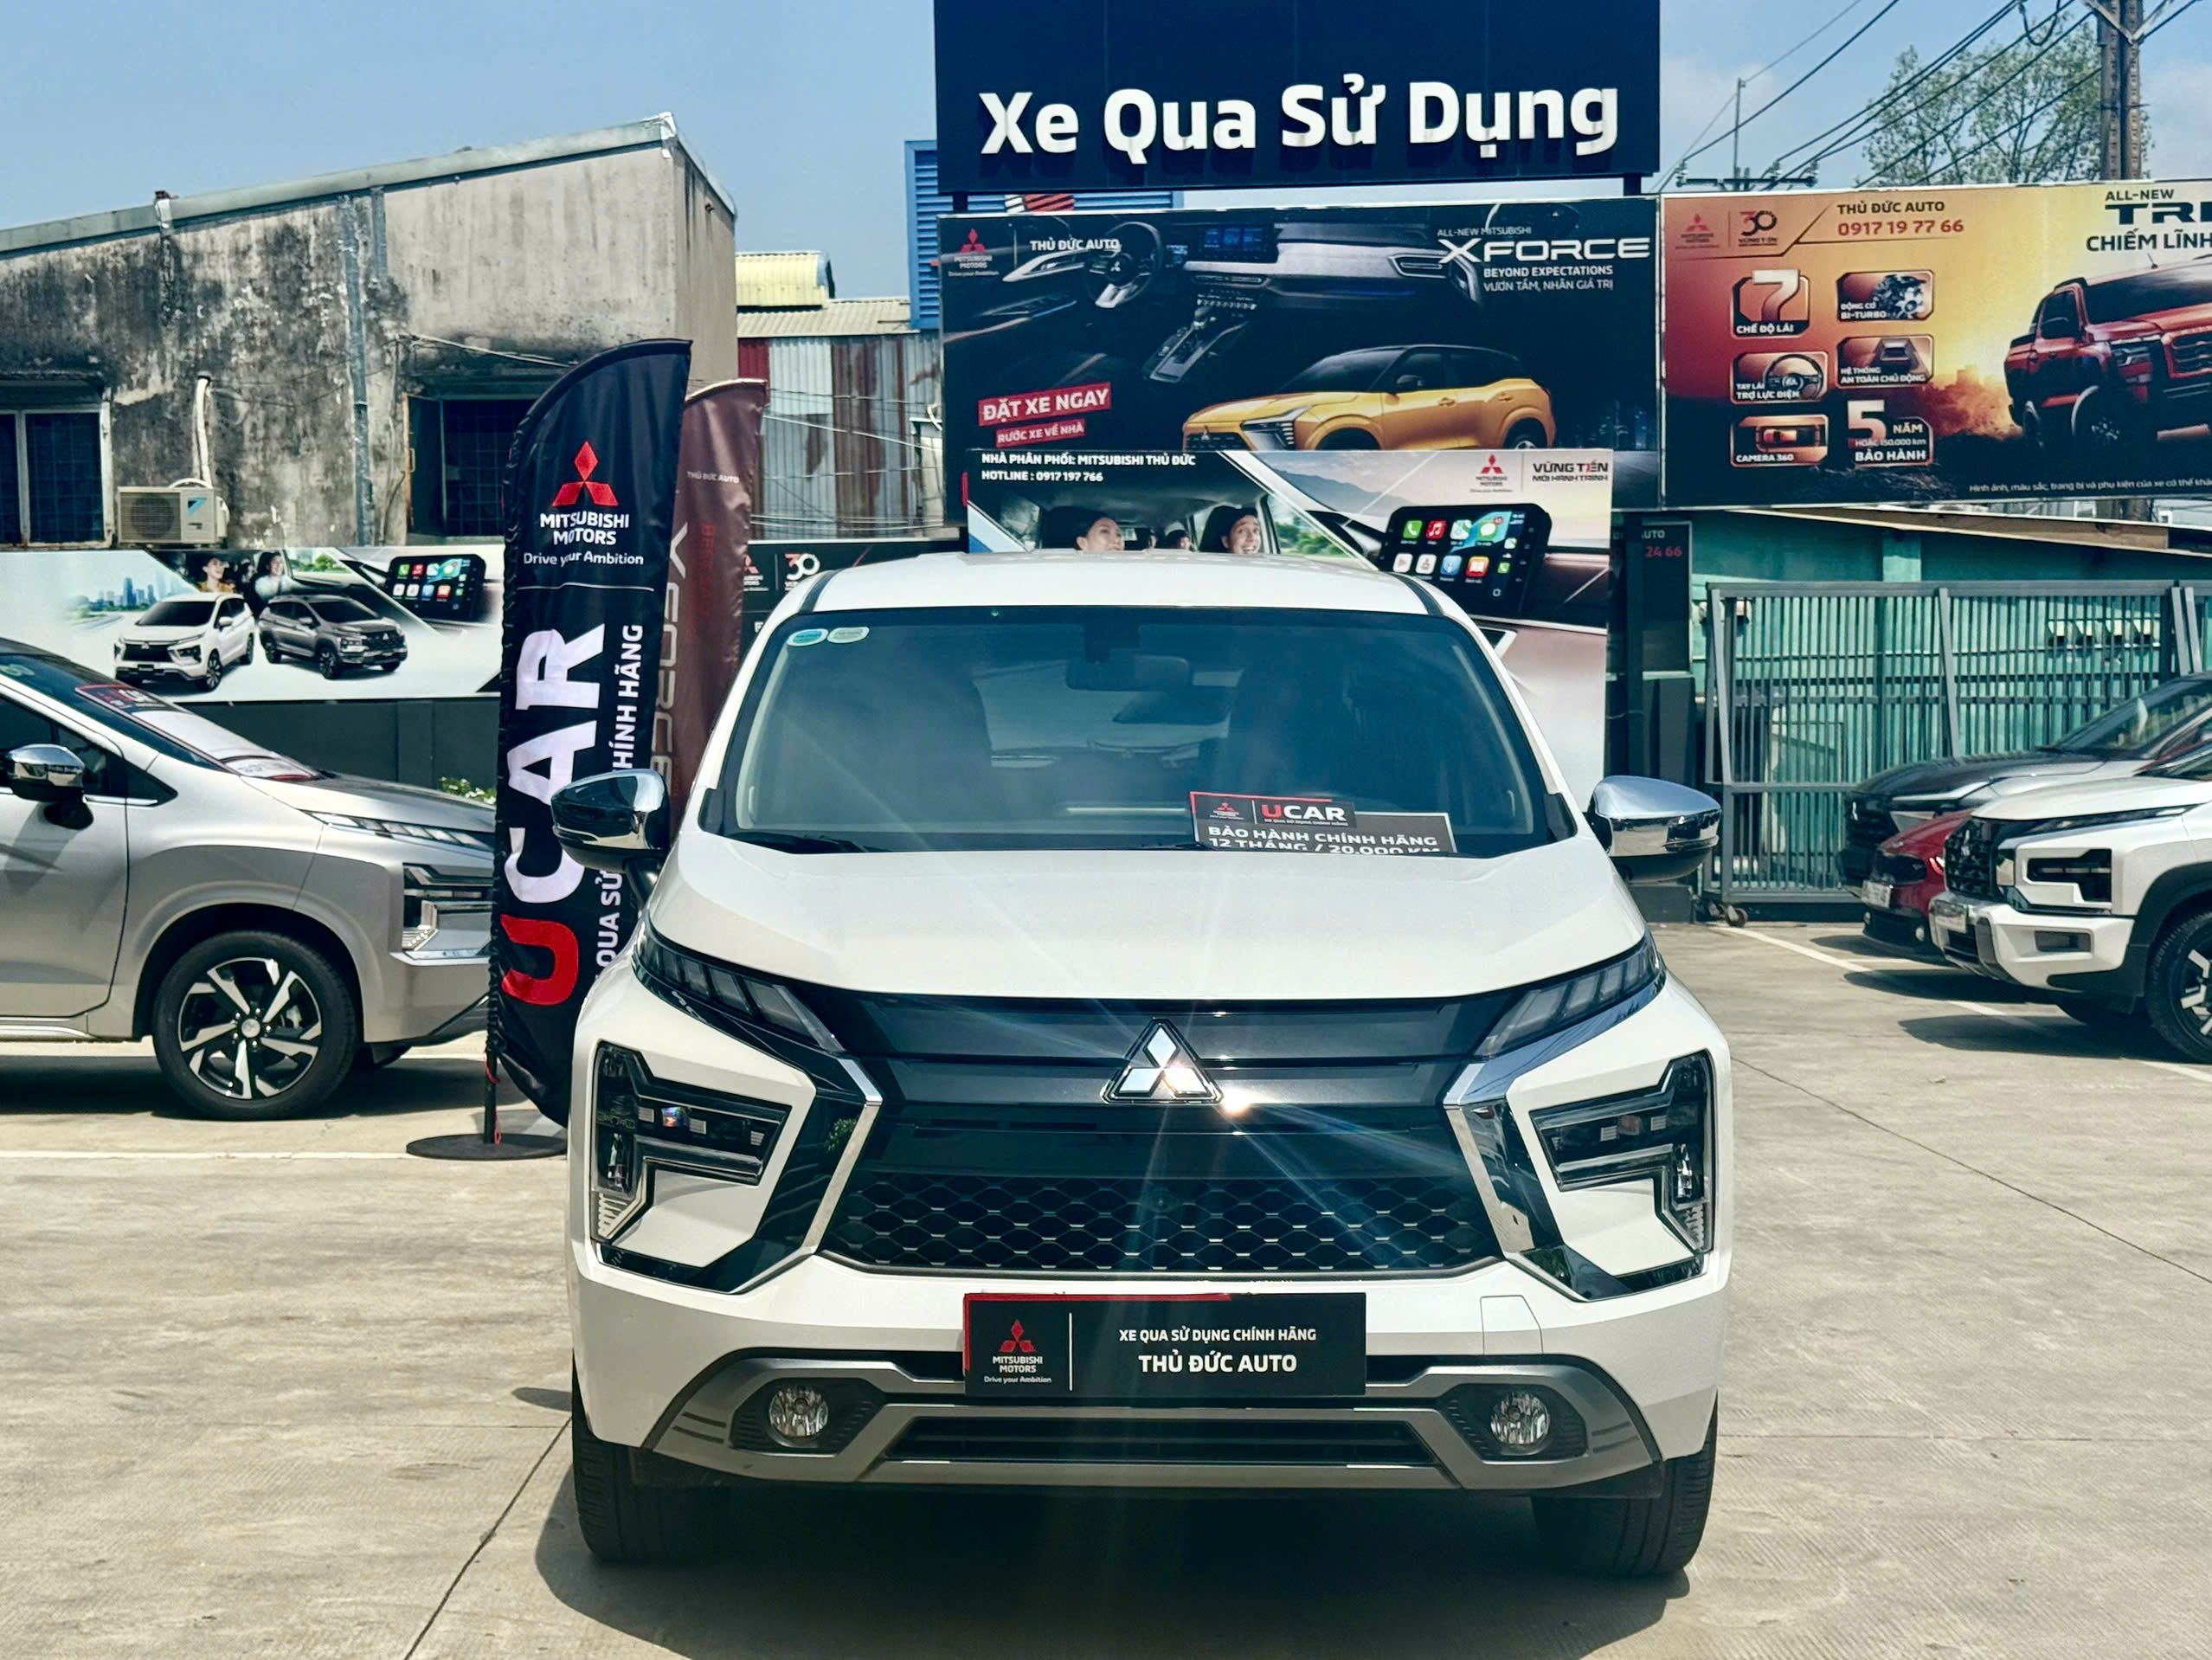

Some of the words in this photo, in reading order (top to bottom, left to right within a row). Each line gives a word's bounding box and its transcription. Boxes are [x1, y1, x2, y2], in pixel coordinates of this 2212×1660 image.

[980, 92, 1079, 154] Xe
[1103, 88, 1257, 165] Qua
[1281, 74, 1386, 148] Sử
[1409, 81, 1618, 159] Dụng
[2105, 190, 2174, 202] ALL-NEW
[1837, 201, 1868, 215] THỦ
[1871, 200, 1901, 214] ĐỨC
[1905, 202, 1945, 213] AUTO
[1437, 228, 1480, 237] ALL-NEW
[1481, 226, 1532, 235] MITSUBISHI
[1837, 222, 1882, 236] 0917
[1888, 221, 1908, 235] 19
[1913, 220, 1935, 234] 77
[1940, 219, 1964, 233] 66
[1030, 236, 1057, 251] THỦ
[1058, 236, 1083, 251] ĐỨC
[1086, 239, 1121, 250] AUTO
[2087, 228, 2157, 251] CHIẾM
[1438, 237, 1650, 264] XFORCE
[1483, 267, 1529, 278] BEYOND
[1532, 265, 1613, 277] EXPECTATIONS
[1576, 278, 1595, 290] GIÁ
[1596, 279, 1613, 291] TRỊ
[1752, 269, 1801, 323] 7
[1736, 322, 1759, 334] CHẾ
[1759, 322, 1775, 335] ĐỘ
[1776, 323, 1794, 334] LÁI
[983, 397, 1021, 422] ĐẶT
[1026, 396, 1051, 415] XE
[1055, 388, 1109, 411] NGAY
[1029, 428, 1043, 440] XE
[1060, 421, 1084, 434] NHÀ
[1847, 399, 1887, 447] 5
[1893, 422, 1923, 434] NĂM
[981, 453, 1008, 464] NHÀ
[1009, 453, 1042, 465] PHÂN
[1077, 454, 1143, 466] MITSUBISHI
[1146, 452, 1169, 466] THỦ
[1172, 452, 1196, 466] ĐỨC
[1855, 448, 1884, 461] BẢO
[1887, 448, 1926, 460] HÀNH
[1577, 459, 1609, 473] TIẾN
[981, 470, 1028, 481] HOTLINE
[1036, 471, 1062, 482] 0917
[1063, 471, 1082, 481] 197
[1083, 472, 1103, 482] 766
[540, 511, 629, 529] MITSUBISHI
[553, 528, 617, 545] MOTORS
[524, 552, 557, 565] Drive
[560, 552, 582, 568] your
[583, 550, 644, 565] Ambition
[614, 623, 643, 698] HÃNG
[608, 705, 638, 770] HÍNH
[1261, 803, 1347, 821] UCAR
[1208, 825, 1249, 838] BẢO
[1253, 827, 1309, 842] HÀNH
[1315, 832, 1376, 845] CHÍNH
[1381, 833, 1437, 846] HÃNG
[1209, 838, 1232, 847] 12
[1119, 1329, 1137, 1342] XE
[1140, 1329, 1169, 1343] QUA
[1172, 1325, 1191, 1342] SỬ
[1192, 1329, 1231, 1344] DỤNG
[1233, 1326, 1276, 1342] CHÍNH
[1278, 1326, 1316, 1342] HÃNG
[1139, 1348, 1183, 1373] THỦ
[1189, 1350, 1233, 1373] ĐỨC
[1238, 1354, 1297, 1373] AUTO
